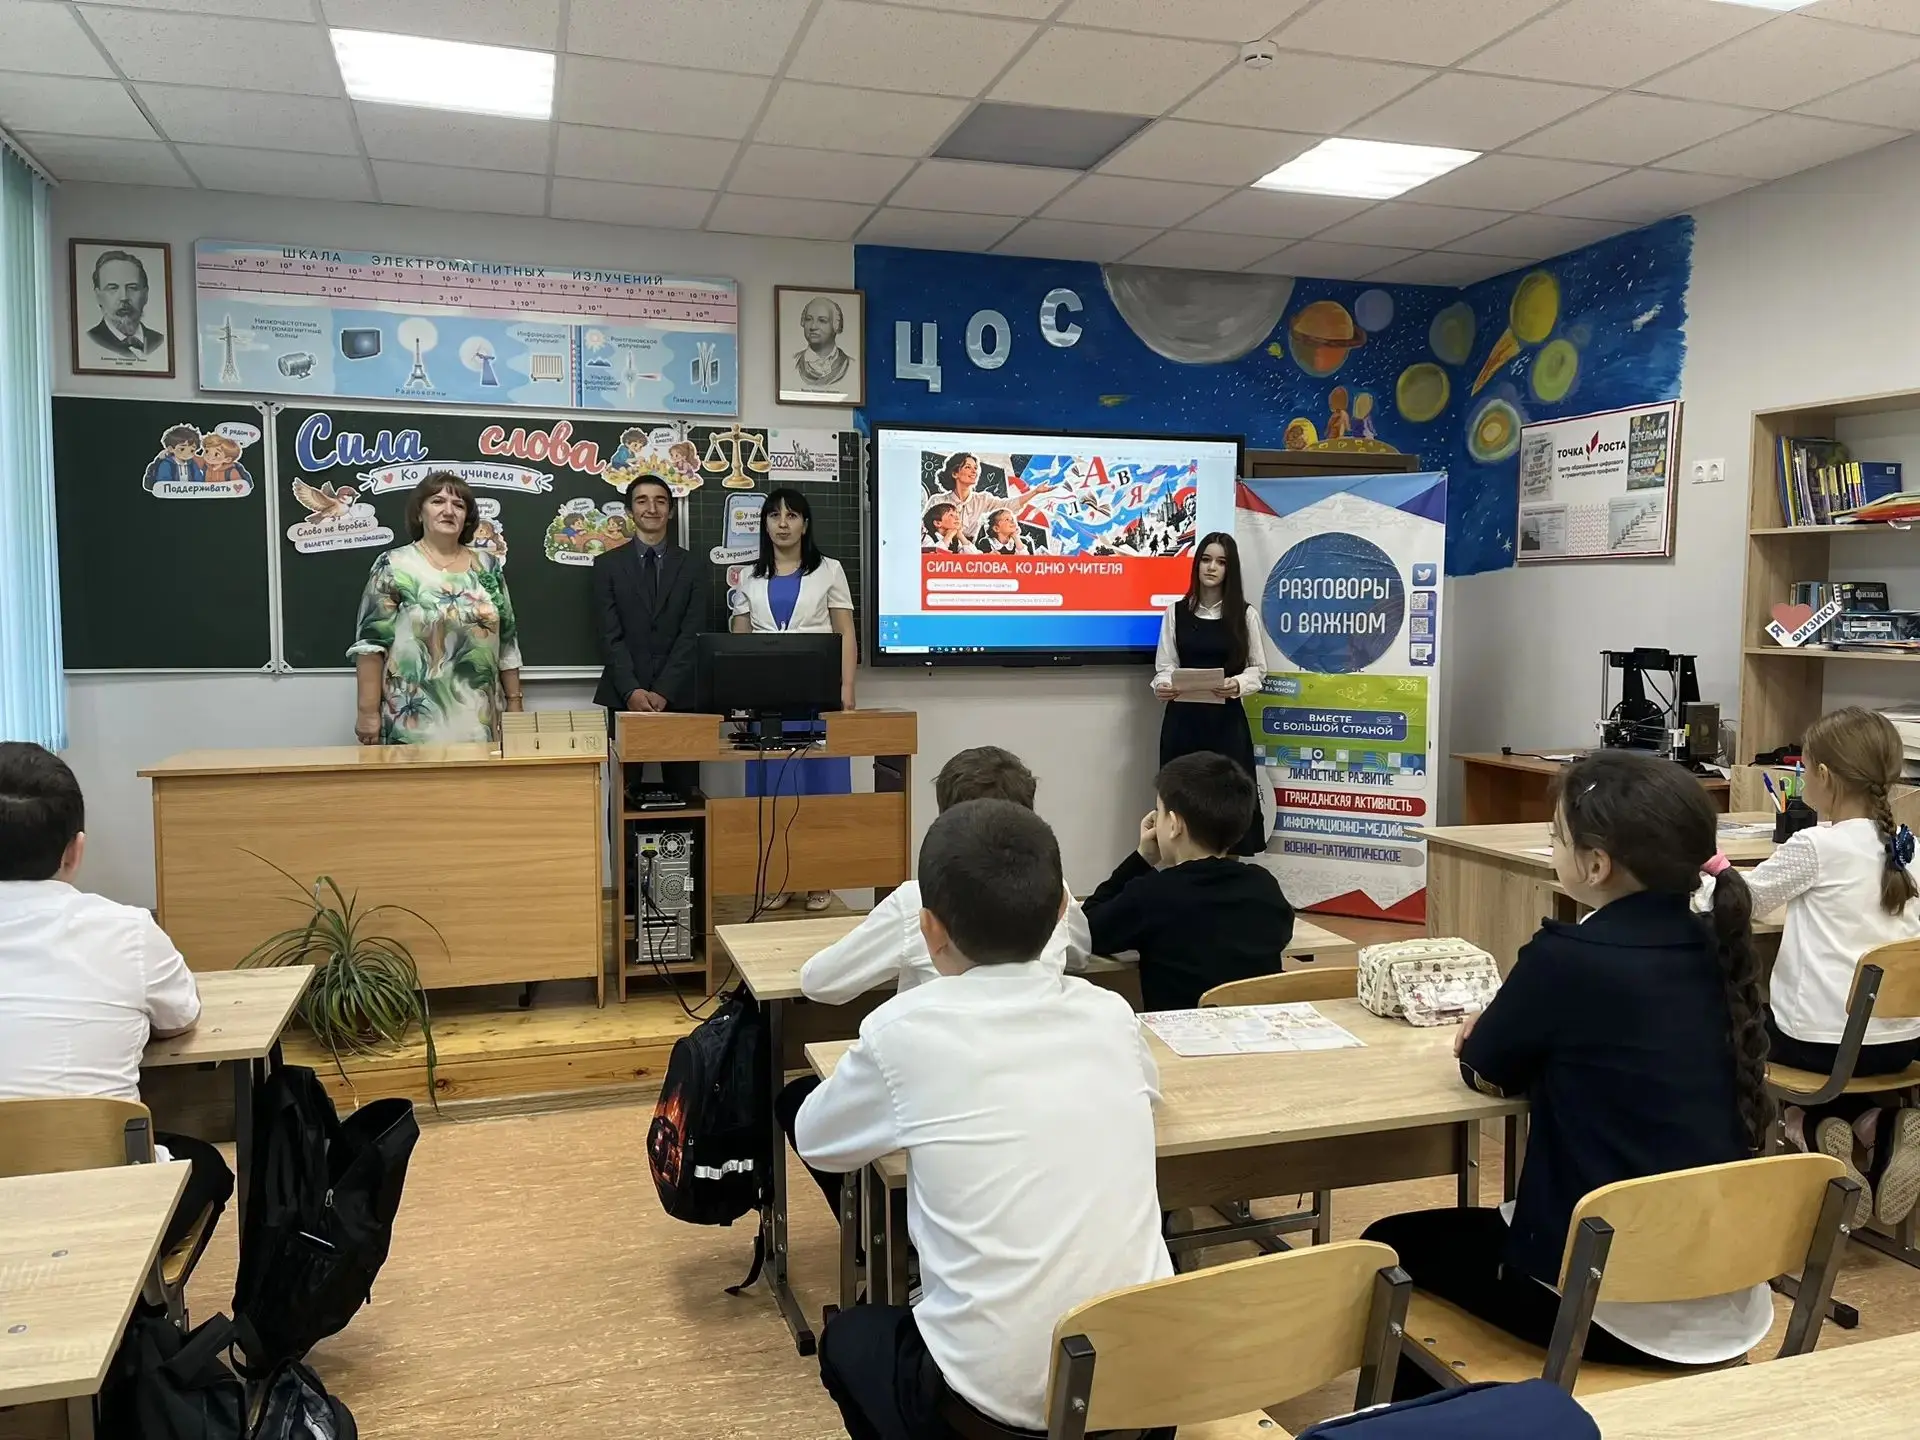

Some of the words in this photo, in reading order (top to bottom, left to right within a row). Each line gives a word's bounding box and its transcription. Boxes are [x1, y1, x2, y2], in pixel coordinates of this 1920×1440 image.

[282, 247, 341, 262] ШКАЛА
[372, 255, 545, 277] ЭЛЕКТРОМАГНИТНЫХ
[572, 271, 663, 285] ИЗЛУЧЕНИЙ
[296, 413, 428, 472] Сила
[479, 420, 607, 474] слова
[1557, 447, 1584, 458] ТОЧКА
[1598, 441, 1626, 453] РОСТА
[770, 455, 795, 468] 2026
[401, 468, 418, 480] Ко
[461, 469, 514, 481] учителя
[163, 483, 231, 494] Поддерживать
[297, 527, 321, 536] Слово
[727, 550, 752, 559] экраном
[926, 561, 962, 573] СИЛА
[966, 561, 1012, 574] СЛОВА.
[1016, 562, 1033, 574] КО
[1035, 562, 1065, 575] ДНЮ
[1068, 562, 1124, 575] УЧИТЕЛЯ
[1279, 577, 1390, 600] РАЗГОВОРЫ
[1855, 589, 1884, 600] физика
[1280, 612, 1291, 634] О
[1299, 612, 1386, 634] ВАЖНОМ
[1770, 624, 1785, 639] Я
[1791, 602, 1836, 642] ФИЗИКУ
[1309, 714, 1352, 723] ВМЕСТЕ
[1273, 722, 1280, 730] С
[1283, 721, 1339, 733] БОЛЬШОЙ
[1342, 725, 1393, 735] СТРАНОЙ
[1287, 767, 1345, 783] ЛИЧНОСТНОЕ
[1348, 770, 1394, 786] РАЗВИТИЕ
[1285, 791, 1351, 807] ГРАЖДАНСКАЯ
[1355, 797, 1412, 812] АКТИВНОСТЬ
[1284, 840, 1402, 862] ВОЕННО-ПАТРИОТИЧЕСКОЕ
